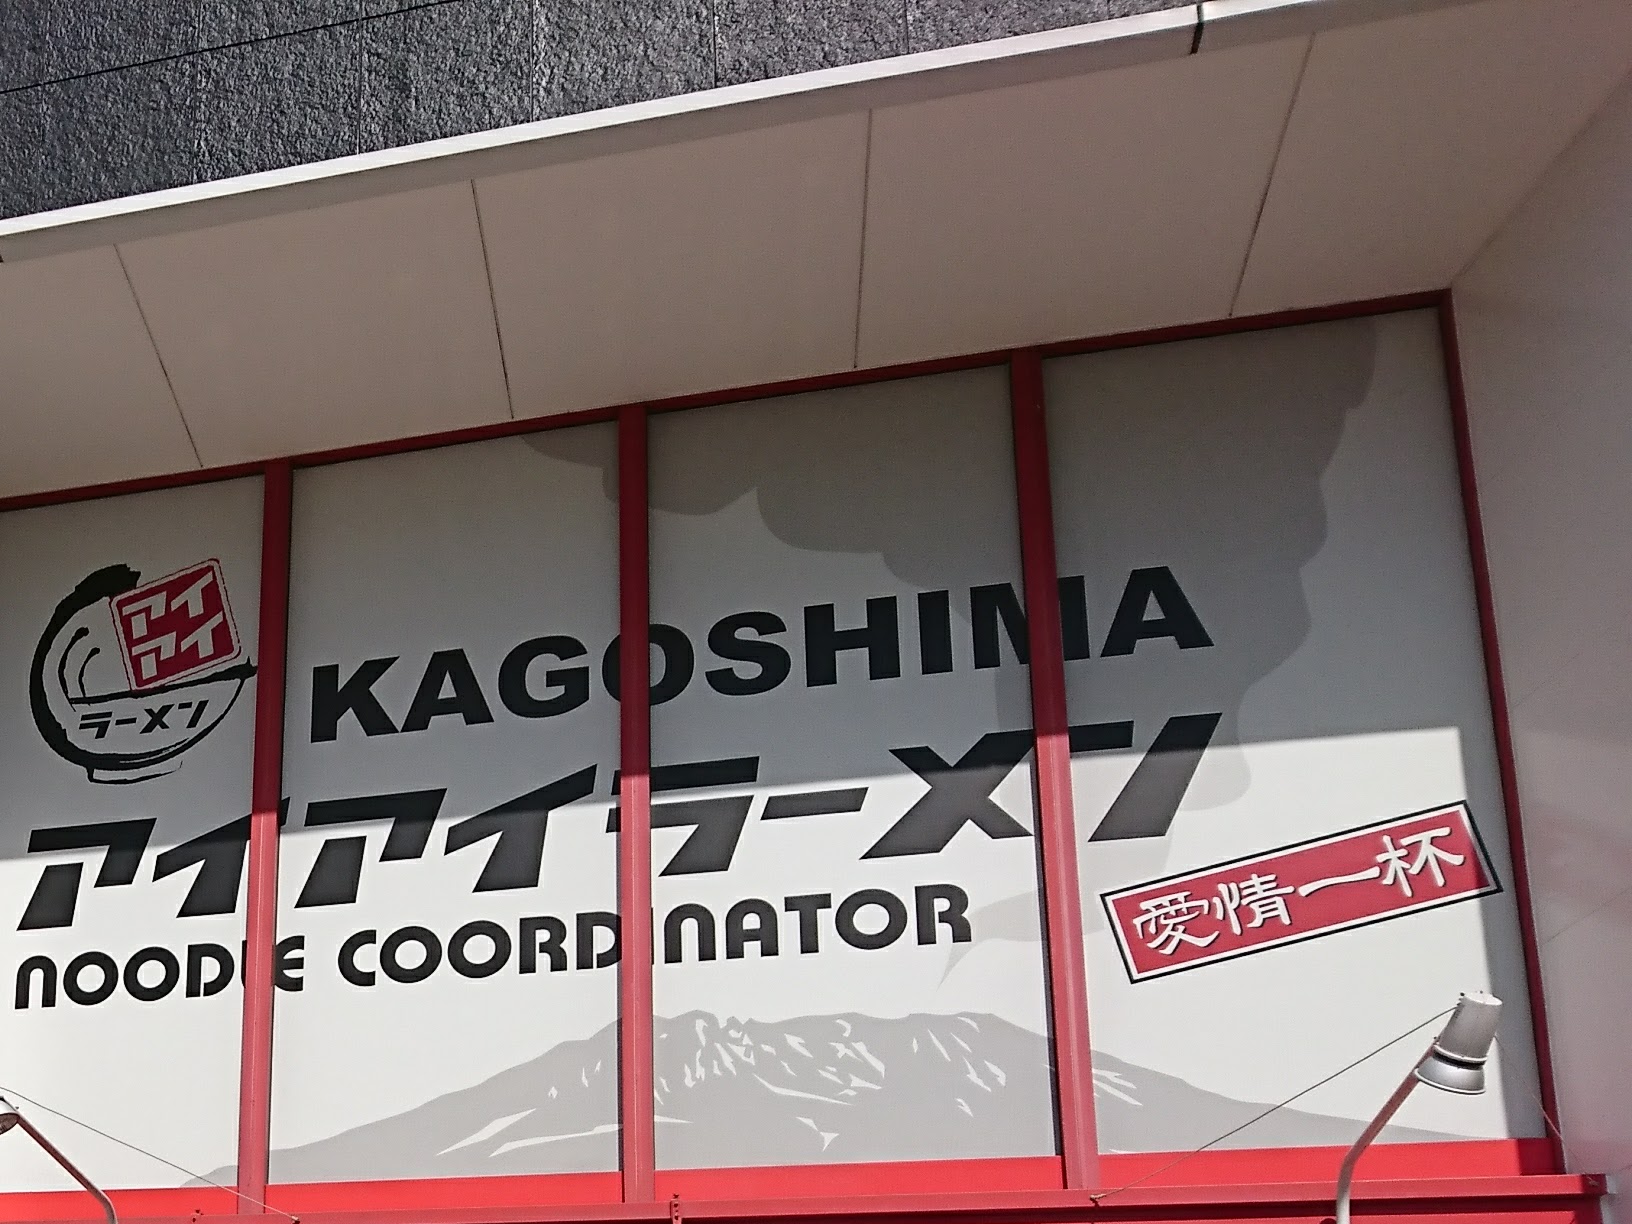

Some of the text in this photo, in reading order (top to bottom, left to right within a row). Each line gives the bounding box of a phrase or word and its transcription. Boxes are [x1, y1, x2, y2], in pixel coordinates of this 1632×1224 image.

[122, 570, 214, 639] アイ
[131, 610, 224, 681] アイ
[311, 565, 1215, 744] KAGOSHIMA
[79, 699, 209, 740] ラーメン
[17, 711, 1223, 932] アイアイラーメン
[15, 883, 973, 1010] NOODE COORDNATOR
[1134, 825, 1466, 957] 愛情一杯
